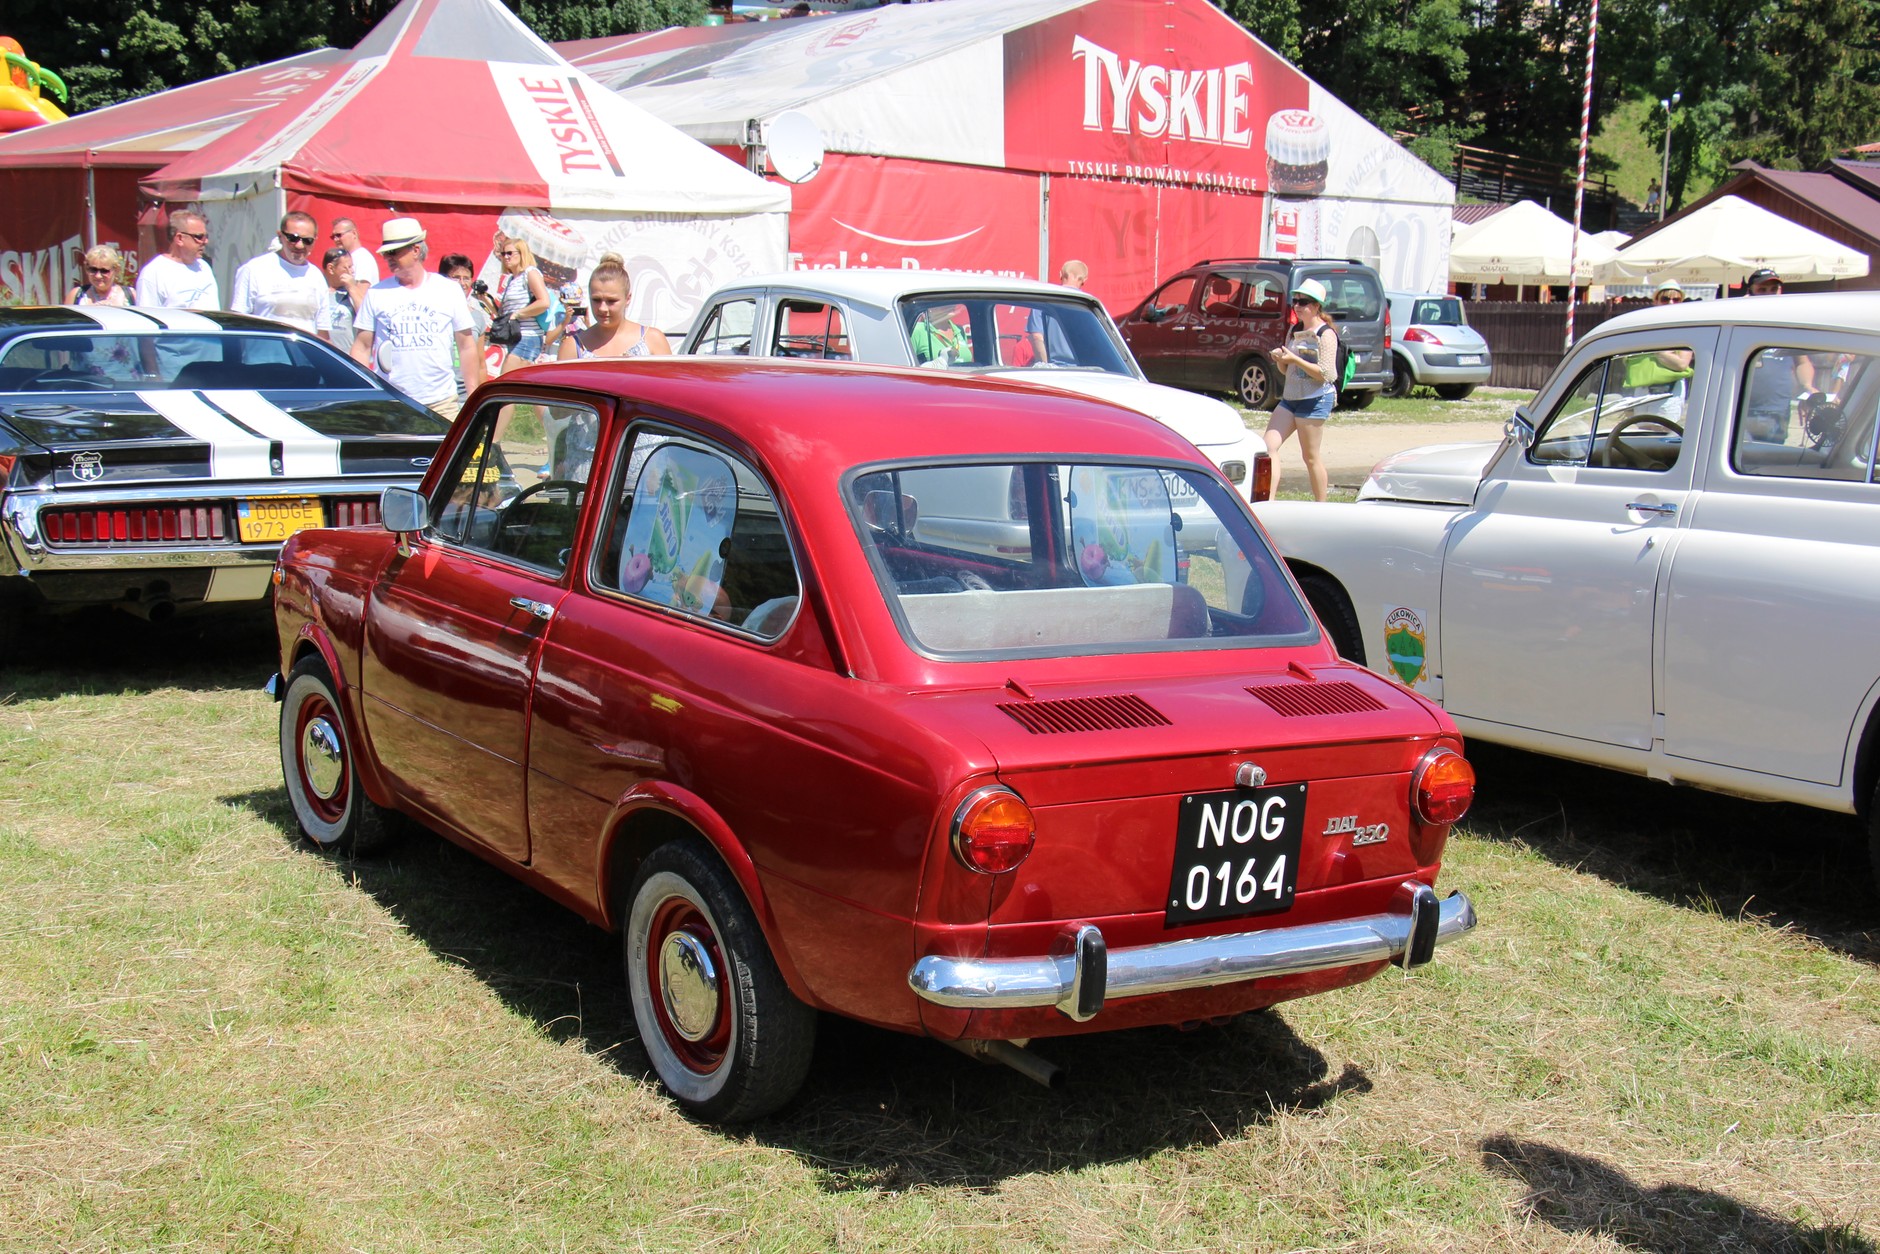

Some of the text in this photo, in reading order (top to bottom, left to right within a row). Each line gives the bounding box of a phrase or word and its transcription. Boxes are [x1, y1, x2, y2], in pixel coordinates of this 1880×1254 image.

[1072, 34, 1254, 149] TYSKIE
[518, 77, 602, 175] TYSKIE
[1068, 161, 1119, 177] TYSKIE
[1125, 165, 1190, 183] BROWARY
[632, 210, 722, 241] BROWARY
[391, 334, 434, 348] CLASS
[82, 468, 97, 478] PL
[255, 502, 313, 520] DODGE
[246, 522, 286, 539] 1973
[1197, 796, 1287, 849] NOG
[1322, 815, 1359, 835] FIAT
[1353, 823, 1390, 846] 850
[1186, 854, 1287, 911] 0164
